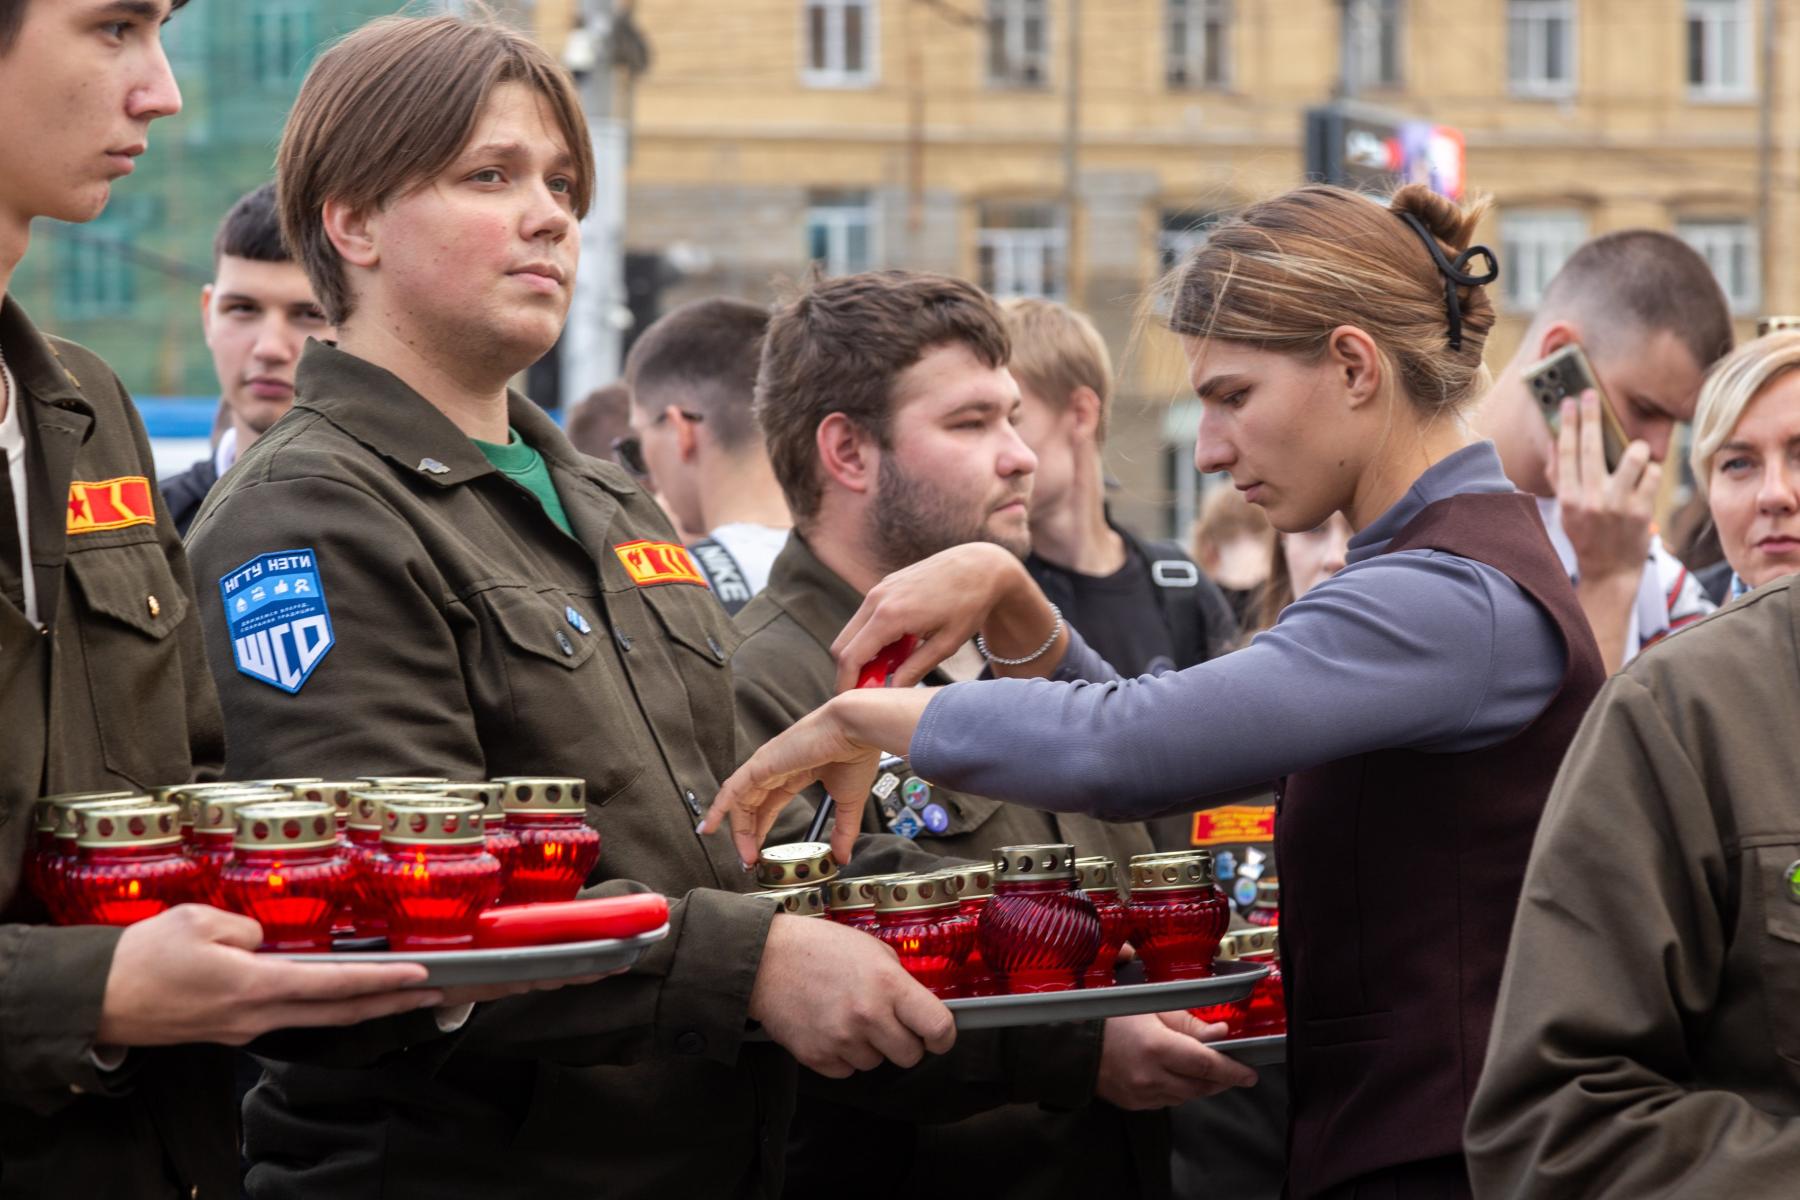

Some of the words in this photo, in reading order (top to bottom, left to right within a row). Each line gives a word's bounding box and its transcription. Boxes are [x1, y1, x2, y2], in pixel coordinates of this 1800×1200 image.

[224, 563, 263, 593] НГТУ
[267, 555, 312, 571] НЭТИ
[694, 545, 750, 602] NIKE
[235, 614, 331, 689] ШСО
